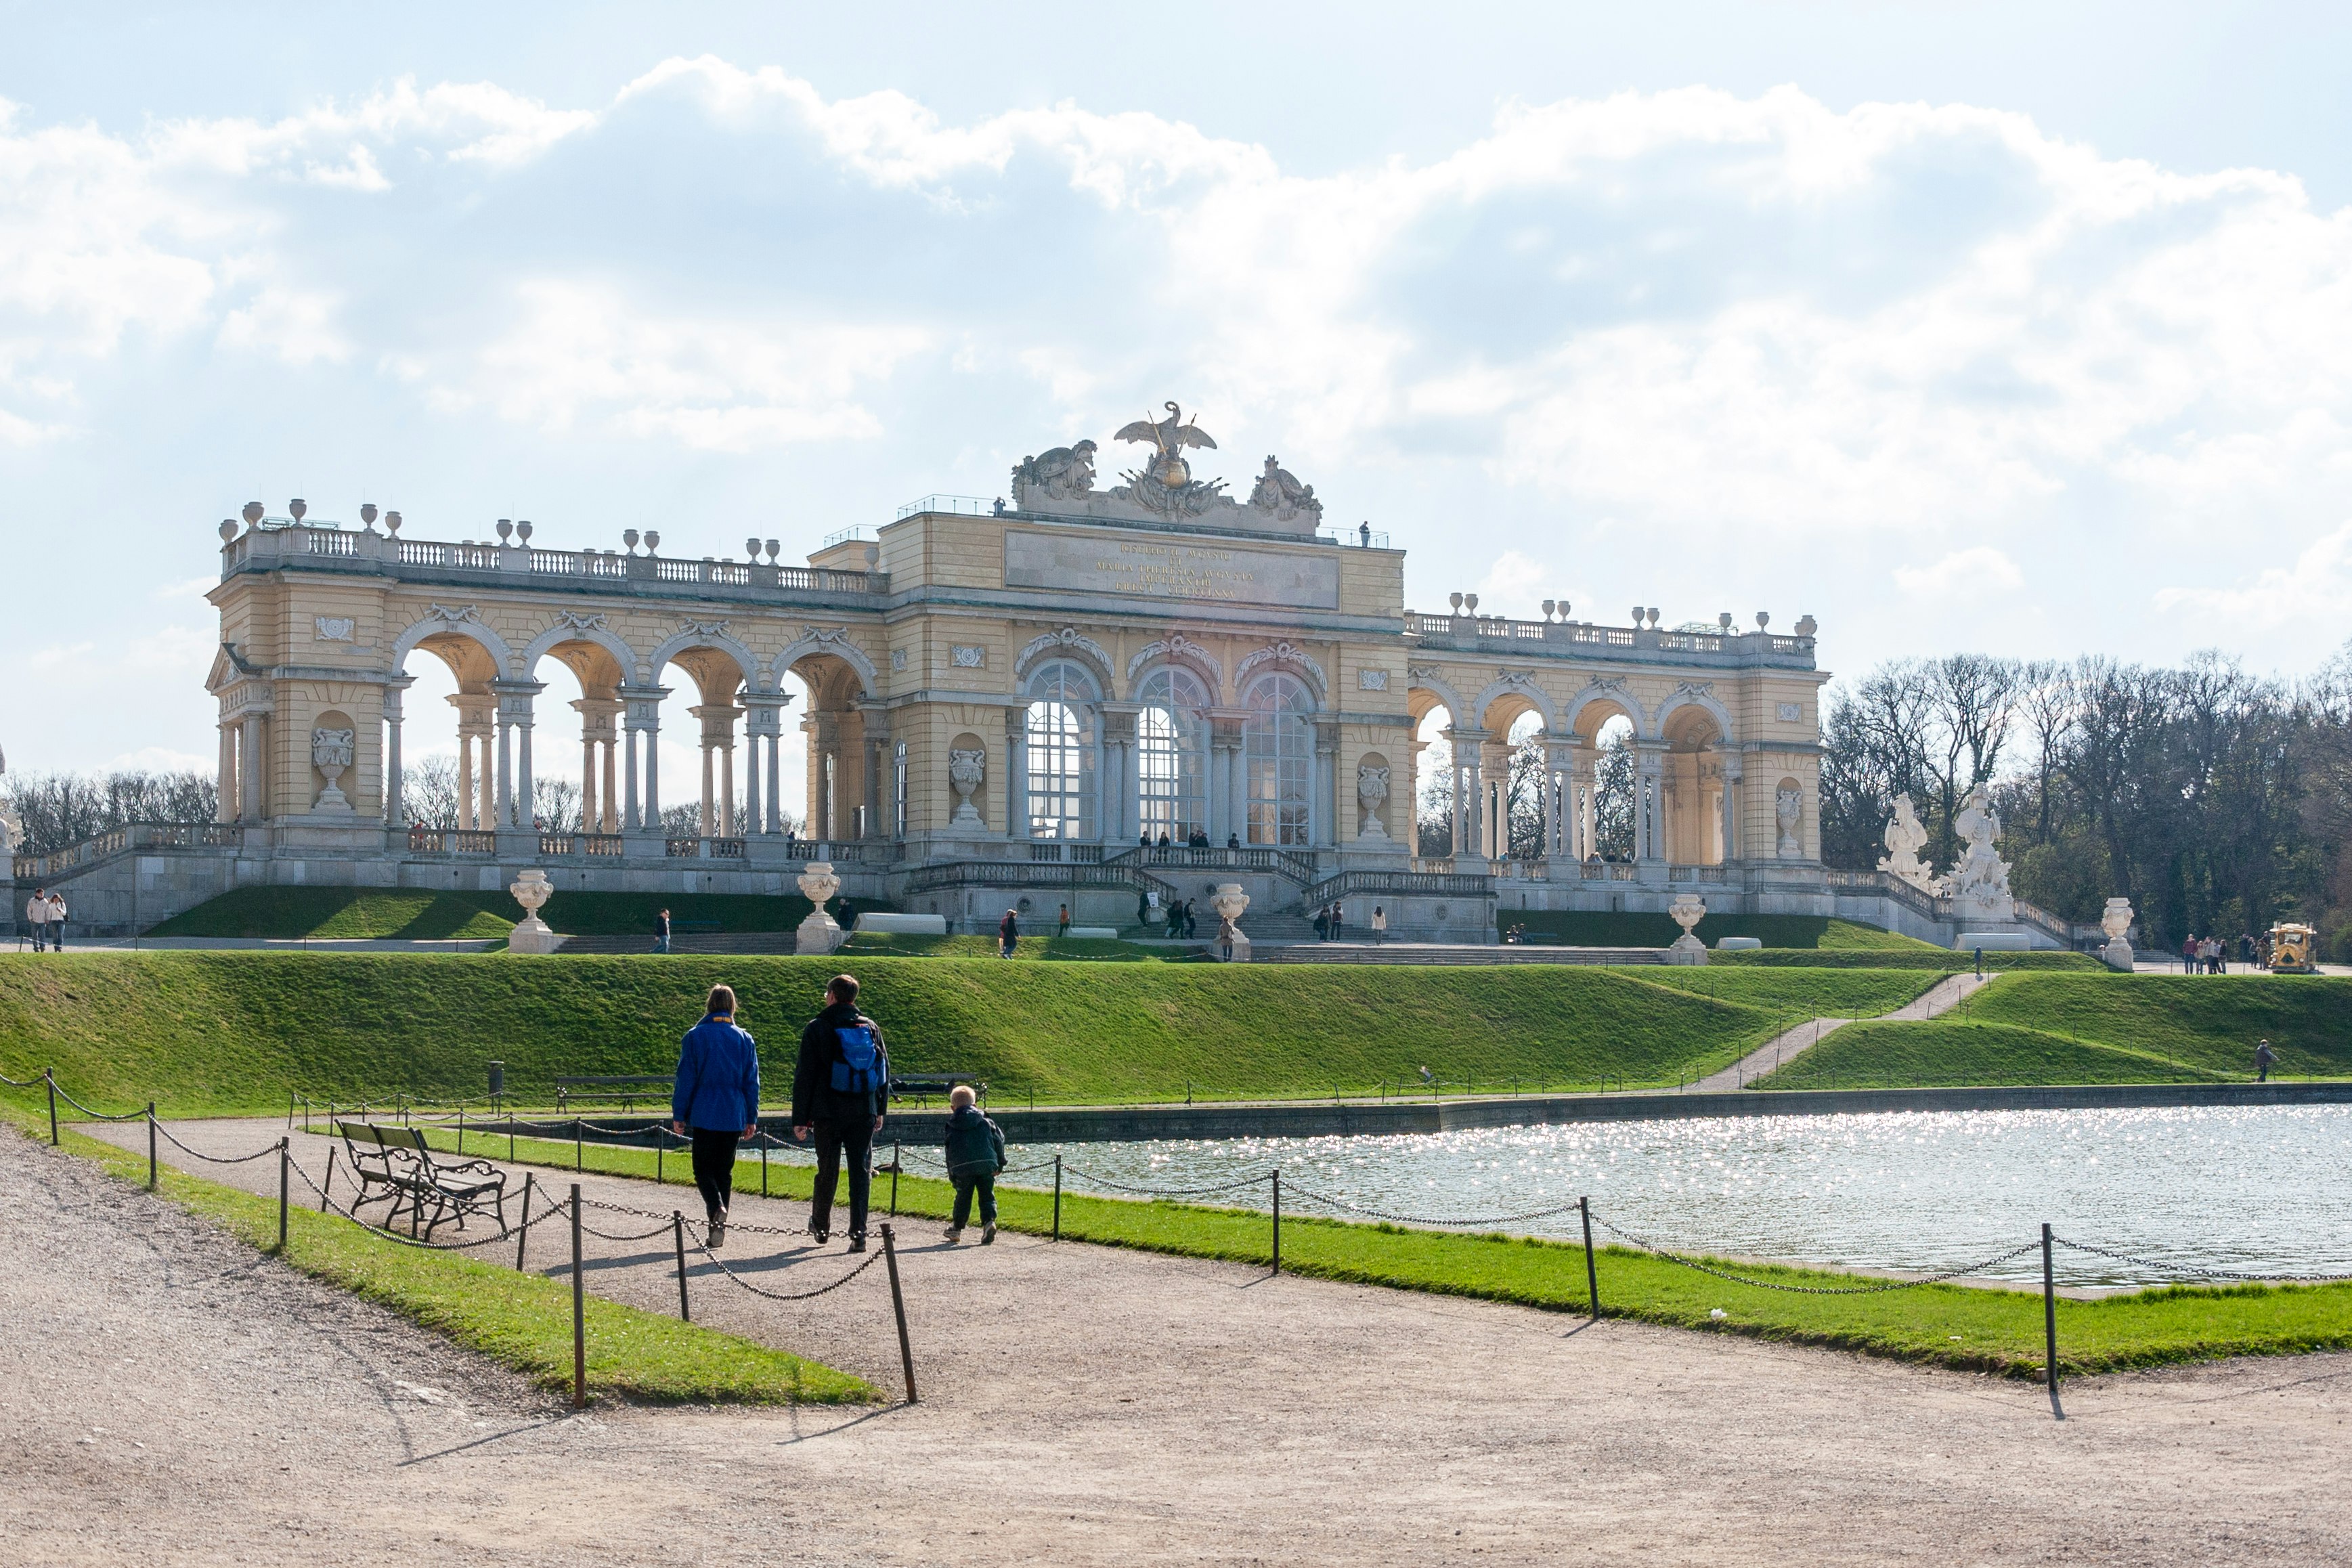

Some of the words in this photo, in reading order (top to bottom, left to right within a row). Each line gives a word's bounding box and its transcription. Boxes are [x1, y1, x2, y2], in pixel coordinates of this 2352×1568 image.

[1121, 543, 1167, 555] IOSEPHO
[1169, 557, 1182, 566] ET
[1097, 561, 1133, 573] MARIA
[1139, 564, 1195, 576] THERESIA
